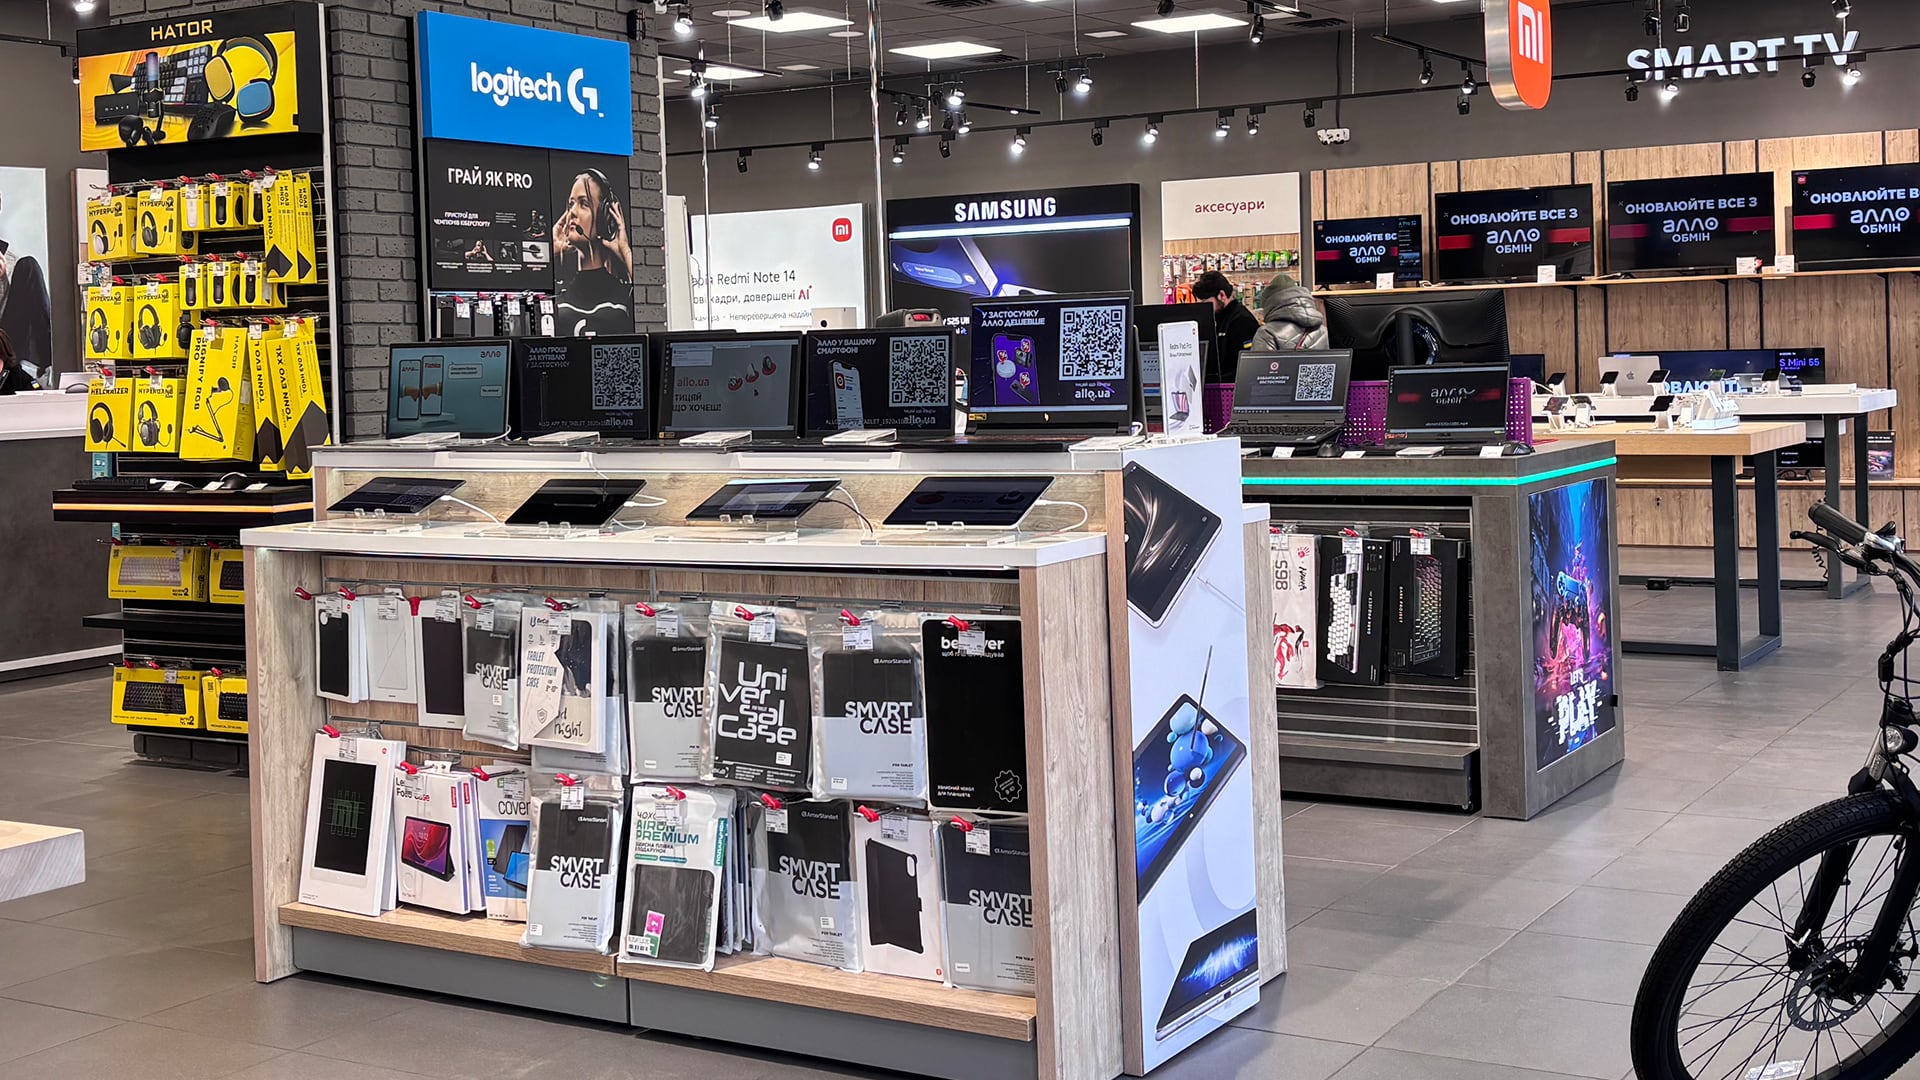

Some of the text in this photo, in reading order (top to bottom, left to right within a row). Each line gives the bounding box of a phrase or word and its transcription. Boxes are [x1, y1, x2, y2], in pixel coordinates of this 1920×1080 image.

[151, 20, 213, 40] HATOR
[1626, 30, 1860, 81] SMART TV
[470, 61, 562, 107] logitech
[447, 165, 533, 189] ГРАЙ ЯК PRO
[1810, 187, 1907, 205] ОНОВЛЮЙТЕ
[955, 197, 1056, 222] SAMSUNG
[1195, 200, 1265, 214] аксесуари
[1625, 198, 1715, 214] ОНОВЛЮЙТЕ
[1718, 198, 1746, 209] ВСЕ
[1450, 209, 1538, 225] ОНОВЛЮЙТЕ
[1540, 209, 1566, 220] ВСЕ
[1850, 207, 1911, 224] алло
[1663, 217, 1719, 233] алло
[1860, 223, 1901, 234] ОБМІН
[1325, 232, 1398, 244] ОНОВЛЮЙТЕ ВС
[1486, 228, 1541, 244] алло
[1672, 232, 1710, 243] ОБМІН
[1349, 246, 1386, 257] алло
[1496, 244, 1532, 254] ОБМІН
[1355, 256, 1380, 264] ОБМІН
[717, 270, 796, 285] Redmi Note 14
[743, 290, 796, 304] довершені
[798, 289, 810, 300] AI
[988, 310, 1040, 318] ЗАСТОСУНКУ
[1004, 318, 1046, 327] ДЕШЕВШЕ
[194, 337, 202, 361] PRO
[844, 338, 876, 346] ВАШОМУ
[1780, 358, 1786, 366] S
[1788, 358, 1806, 366] Mini
[279, 368, 287, 389] EVO
[676, 376, 710, 387] allo.ua
[1074, 388, 1111, 401] allo.ua
[282, 392, 292, 421] TONN
[689, 404, 722, 412] ХОЧЕШ!
[1276, 560, 1288, 590] S98
[527, 650, 546, 662] TABLET
[526, 664, 558, 677] PROTECTION
[738, 662, 788, 691] Uni
[482, 676, 509, 691] CASE
[526, 676, 540, 688] CASE
[720, 683, 771, 705] ver
[664, 703, 703, 718] CASE
[740, 700, 785, 727] sal
[845, 702, 912, 718] SMVRT
[718, 714, 797, 746] Case
[860, 718, 912, 734] CASE
[498, 800, 531, 816] cover
[636, 820, 676, 832] AIRON
[636, 830, 700, 845] PREMIUM
[550, 856, 604, 874] SMVRT
[779, 856, 840, 881] SMVRT
[560, 872, 601, 889] CASE
[792, 877, 840, 900] CASE
[984, 908, 1033, 928] CASE
